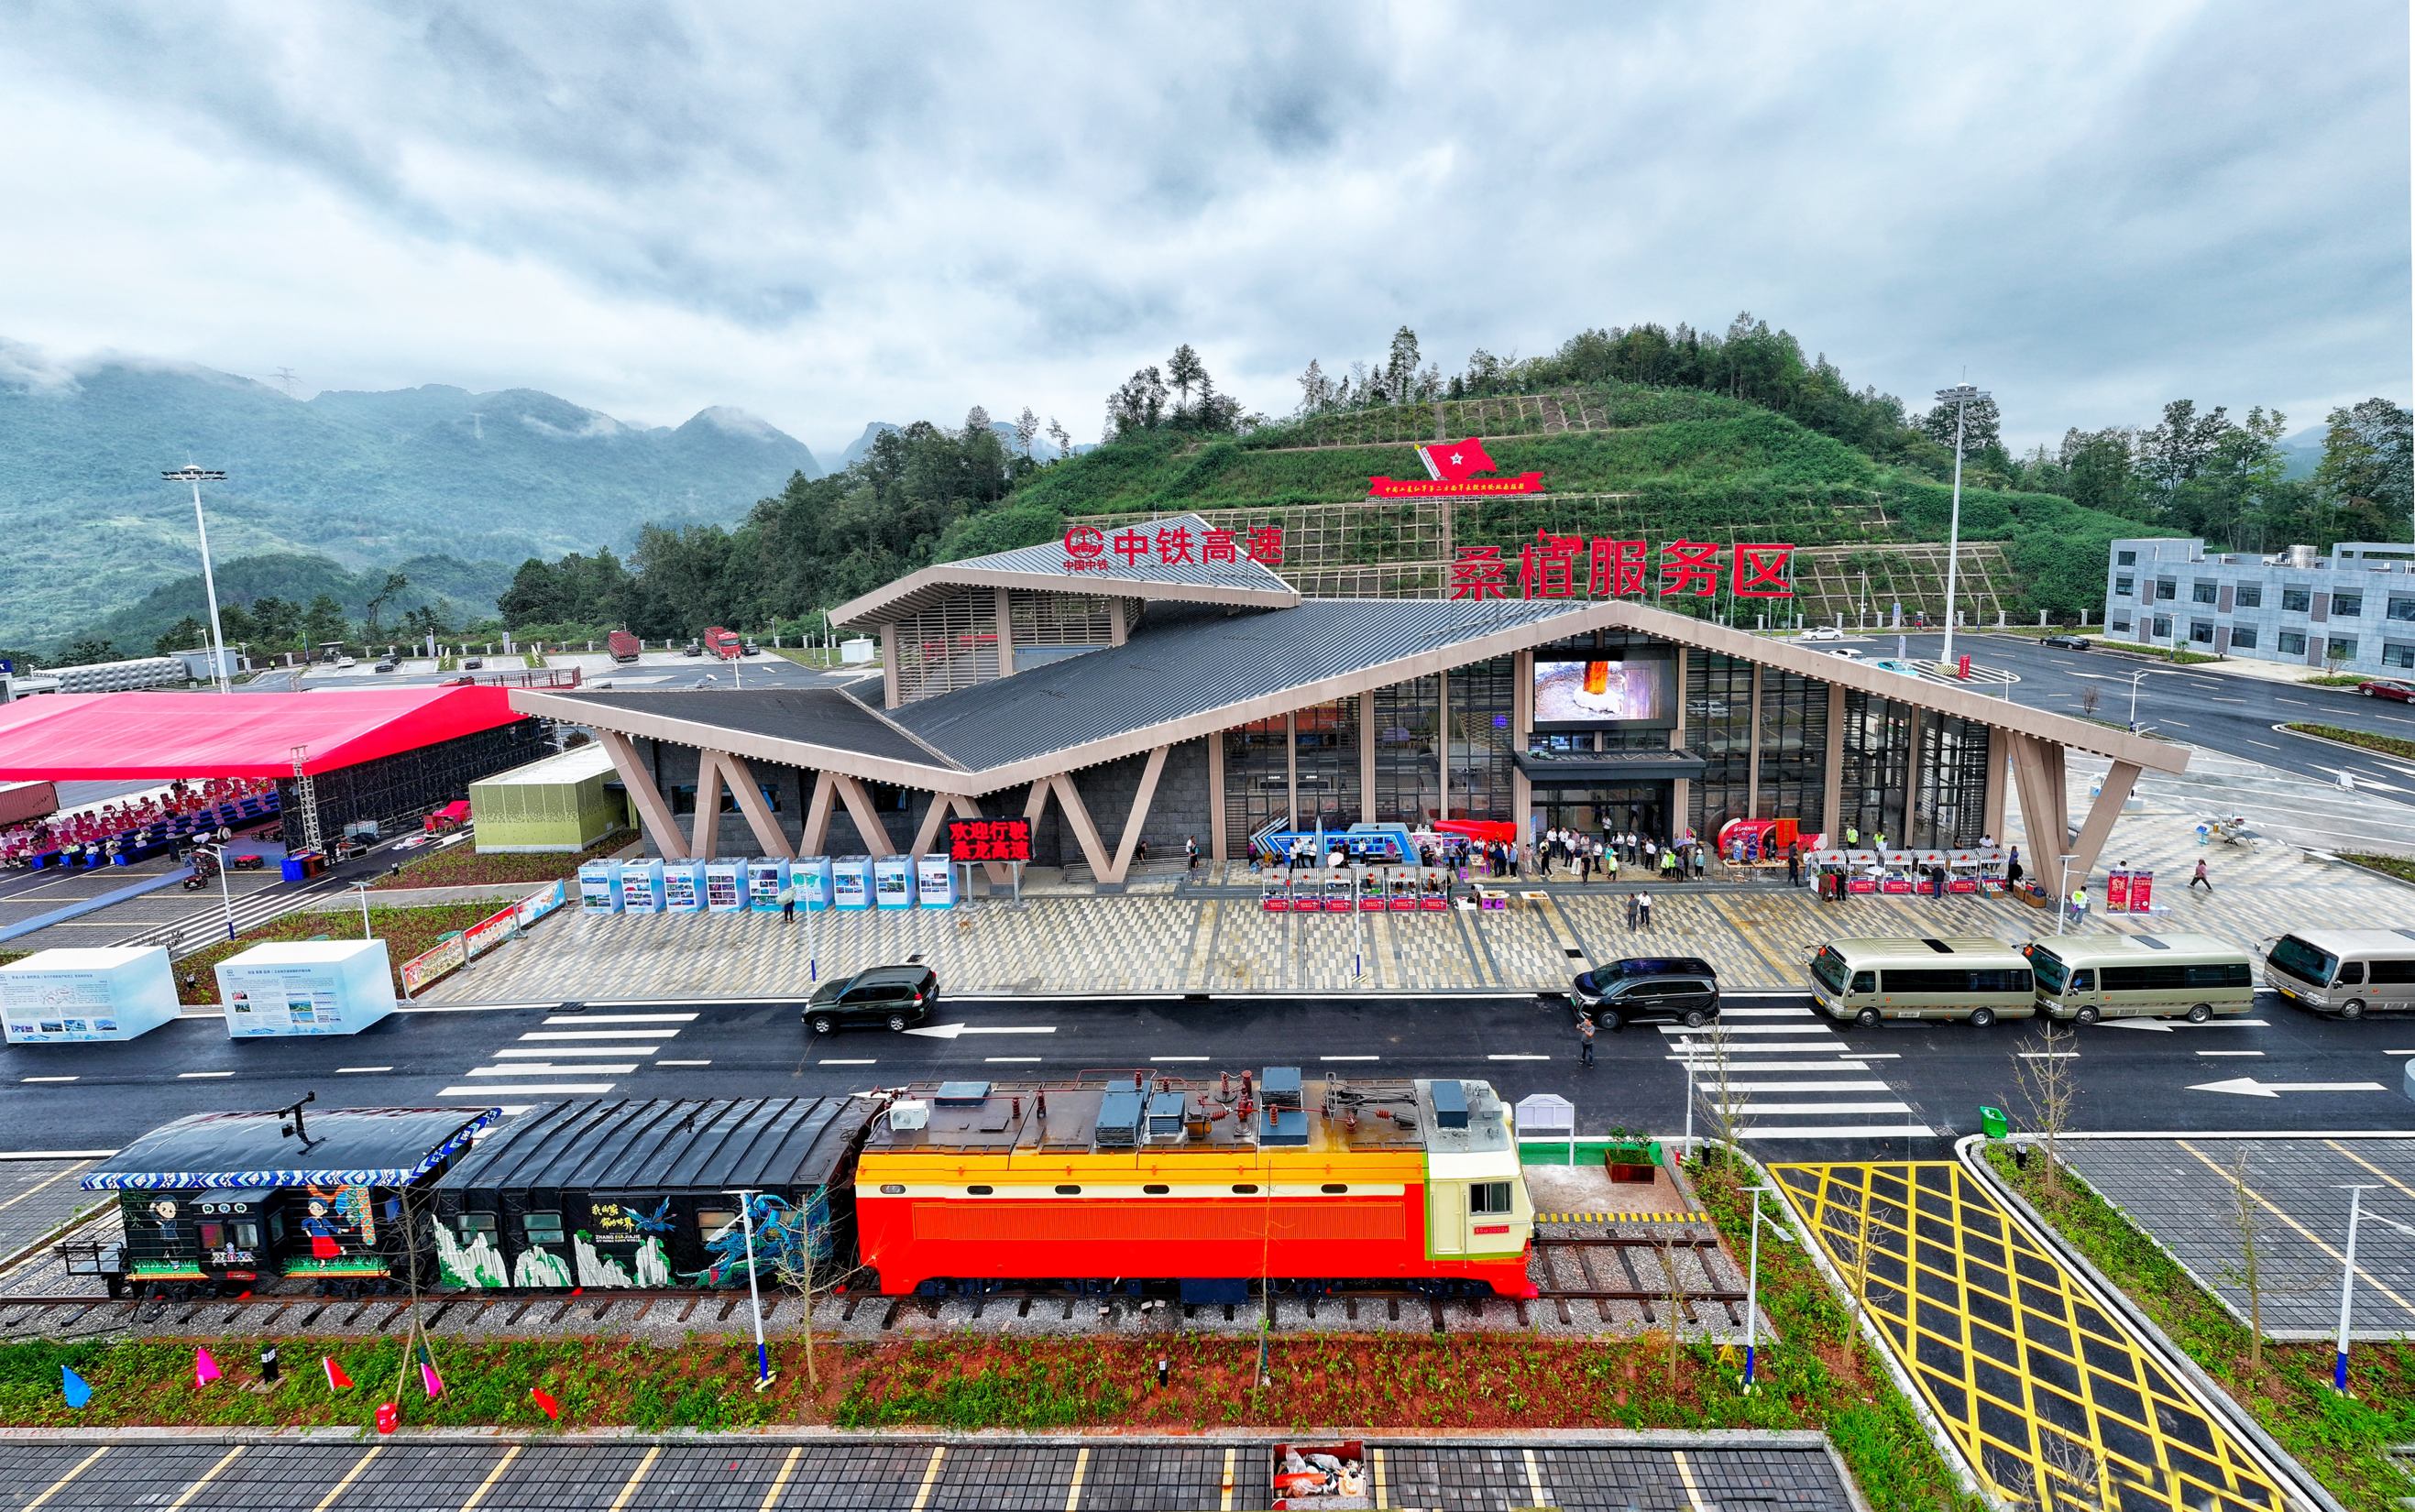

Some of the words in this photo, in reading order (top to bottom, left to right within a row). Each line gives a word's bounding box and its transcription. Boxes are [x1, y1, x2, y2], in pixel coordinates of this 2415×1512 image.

[1114, 525, 1284, 566] 中铁高速
[1063, 559, 1109, 571] 中国中铁
[1451, 539, 1795, 601] 桑植服务区
[949, 820, 1029, 840] 欢迎行驶
[951, 839, 1030, 860] 桑龙高速
